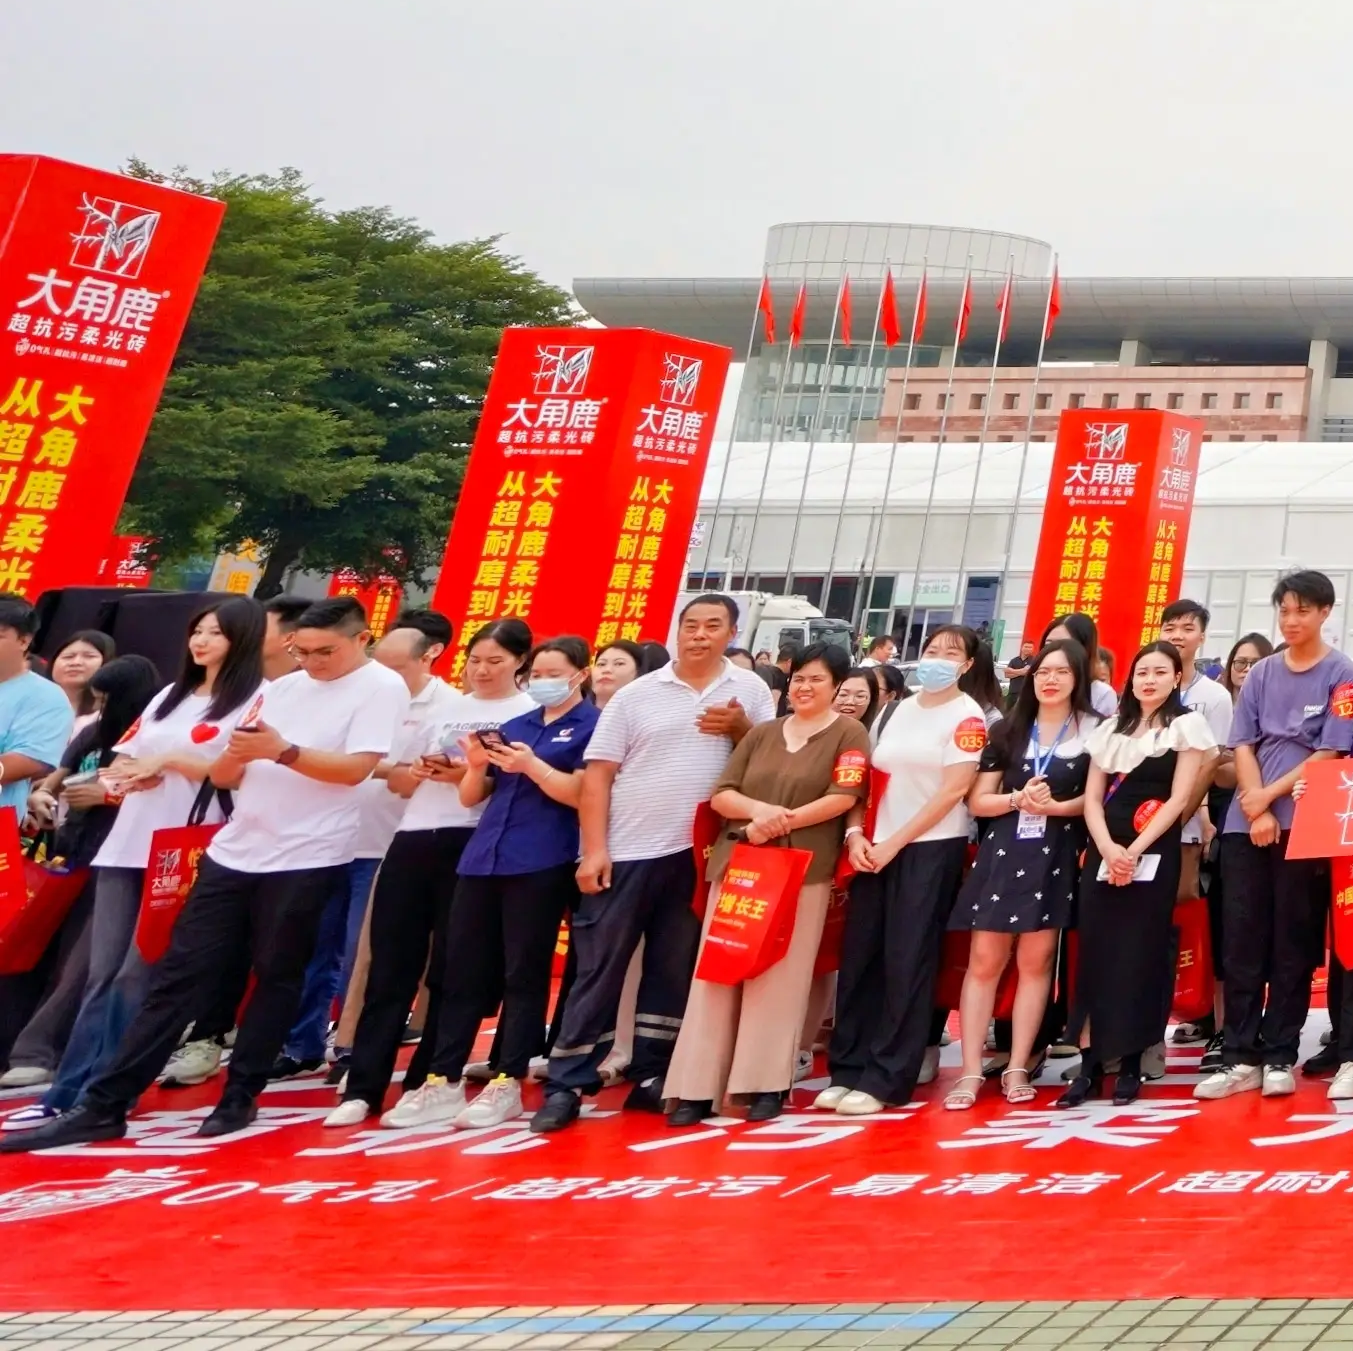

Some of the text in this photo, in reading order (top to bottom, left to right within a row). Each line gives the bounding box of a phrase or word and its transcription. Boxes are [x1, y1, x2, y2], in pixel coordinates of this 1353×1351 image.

[17, 269, 162, 333] 大角鹿
[7, 312, 147, 353] 超抗污柔光砖
[502, 398, 602, 430] 大角鹿
[636, 406, 704, 442] 大角鹿
[497, 430, 596, 445] 超抗污柔光砖
[632, 434, 698, 456] 超抗污柔光砖
[1065, 462, 1137, 486] 大角鹿
[1160, 467, 1193, 493] 大角鹿
[1063, 485, 1135, 498] 超抗污柔光砖
[500, 471, 563, 618] 大角鹿柔光
[960, 735, 983, 748] 035
[837, 770, 862, 784] 126
[475, 1174, 785, 1201] 超抗污
[832, 1172, 1122, 1198] 易清洁
